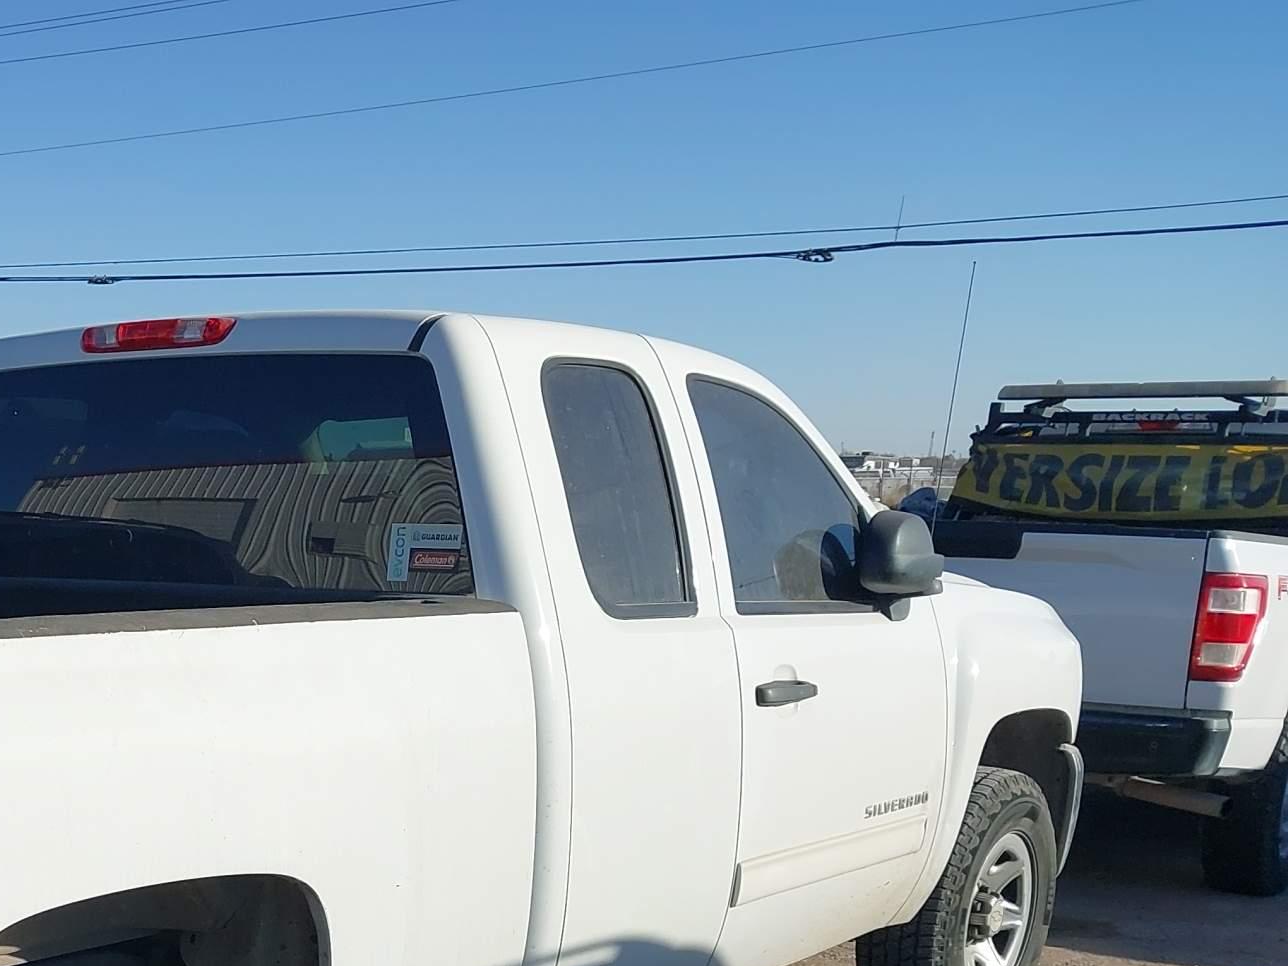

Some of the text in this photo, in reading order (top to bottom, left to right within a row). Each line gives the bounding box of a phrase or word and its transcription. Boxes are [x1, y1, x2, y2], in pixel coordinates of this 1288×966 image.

[1091, 412, 1209, 422] BACKRACK
[421, 532, 460, 542] GUARDIAN
[414, 553, 448, 565] Coleman
[863, 791, 929, 819] SILVERADO
